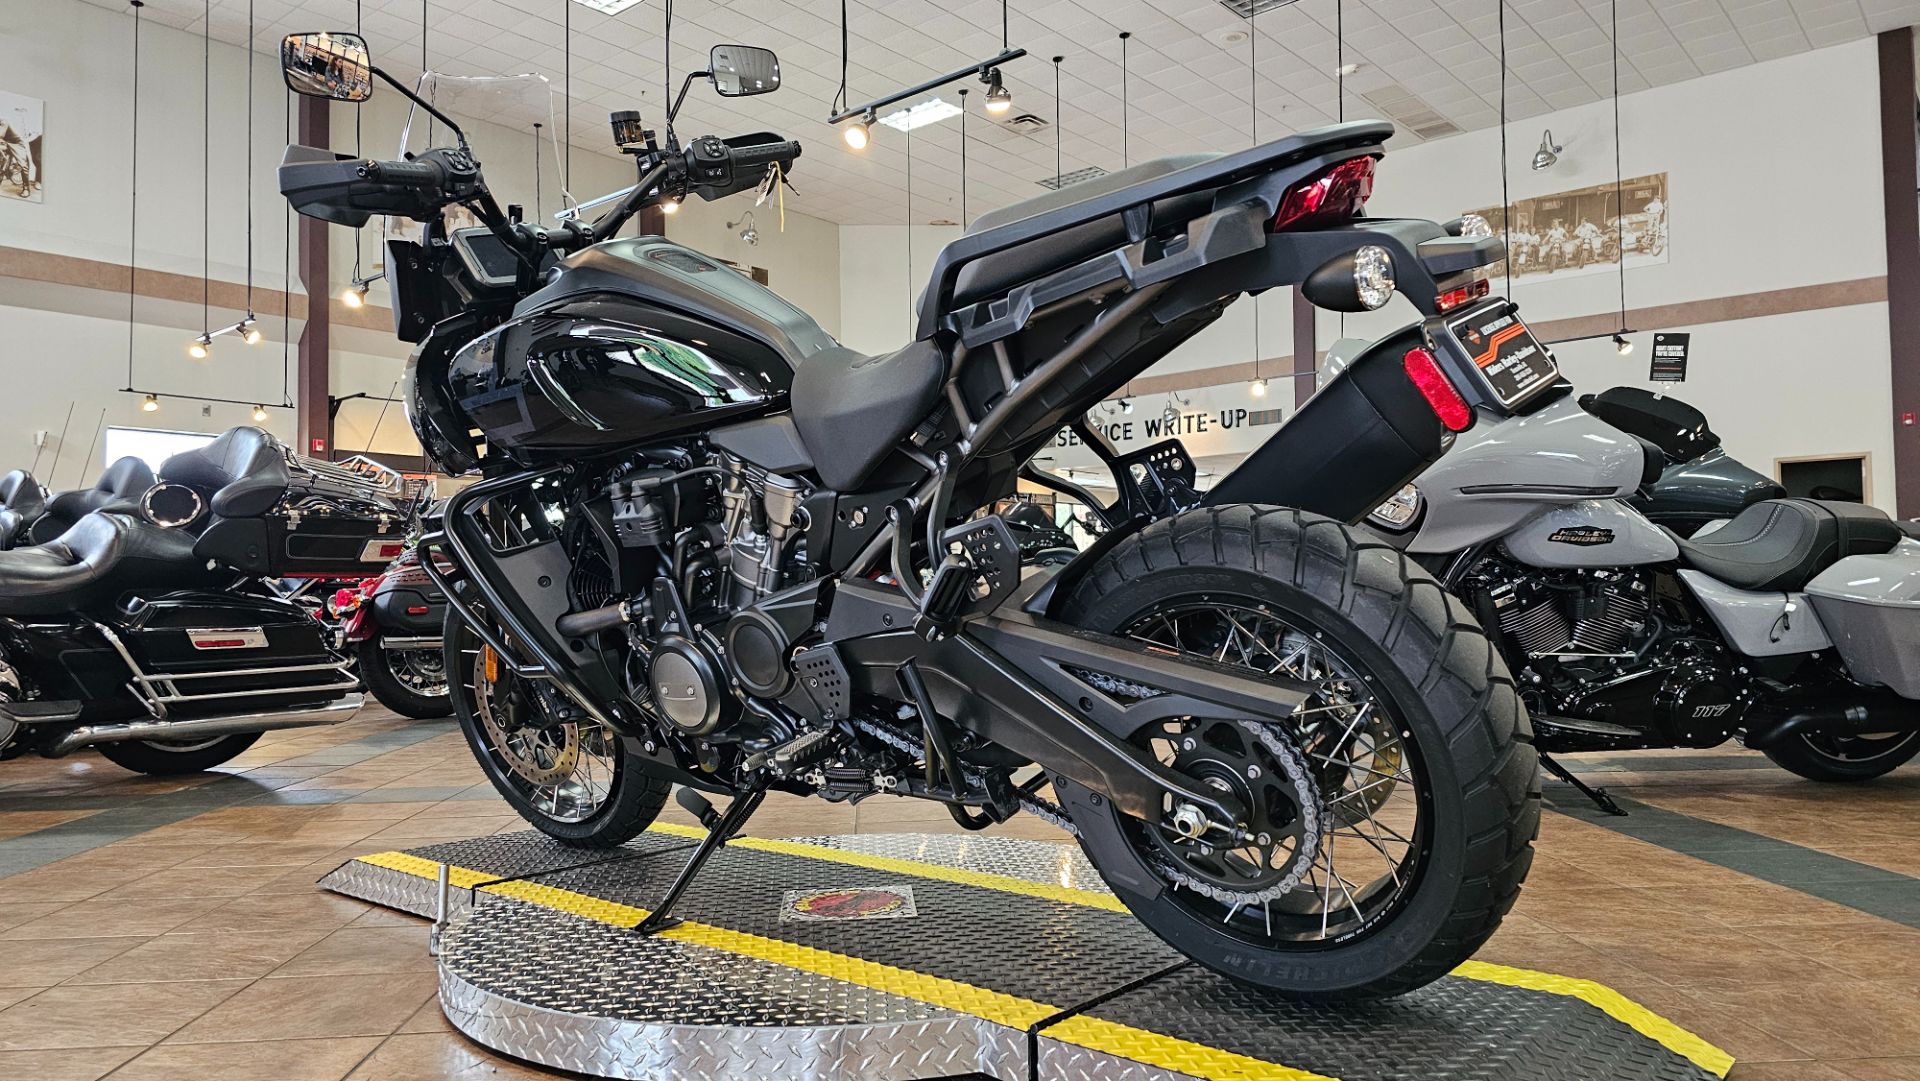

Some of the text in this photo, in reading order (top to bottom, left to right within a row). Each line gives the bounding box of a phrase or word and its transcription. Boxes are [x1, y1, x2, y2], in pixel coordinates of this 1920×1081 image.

[1057, 407, 1248, 447] SEICE WRITE-UP
[1692, 703, 1731, 718] 117
